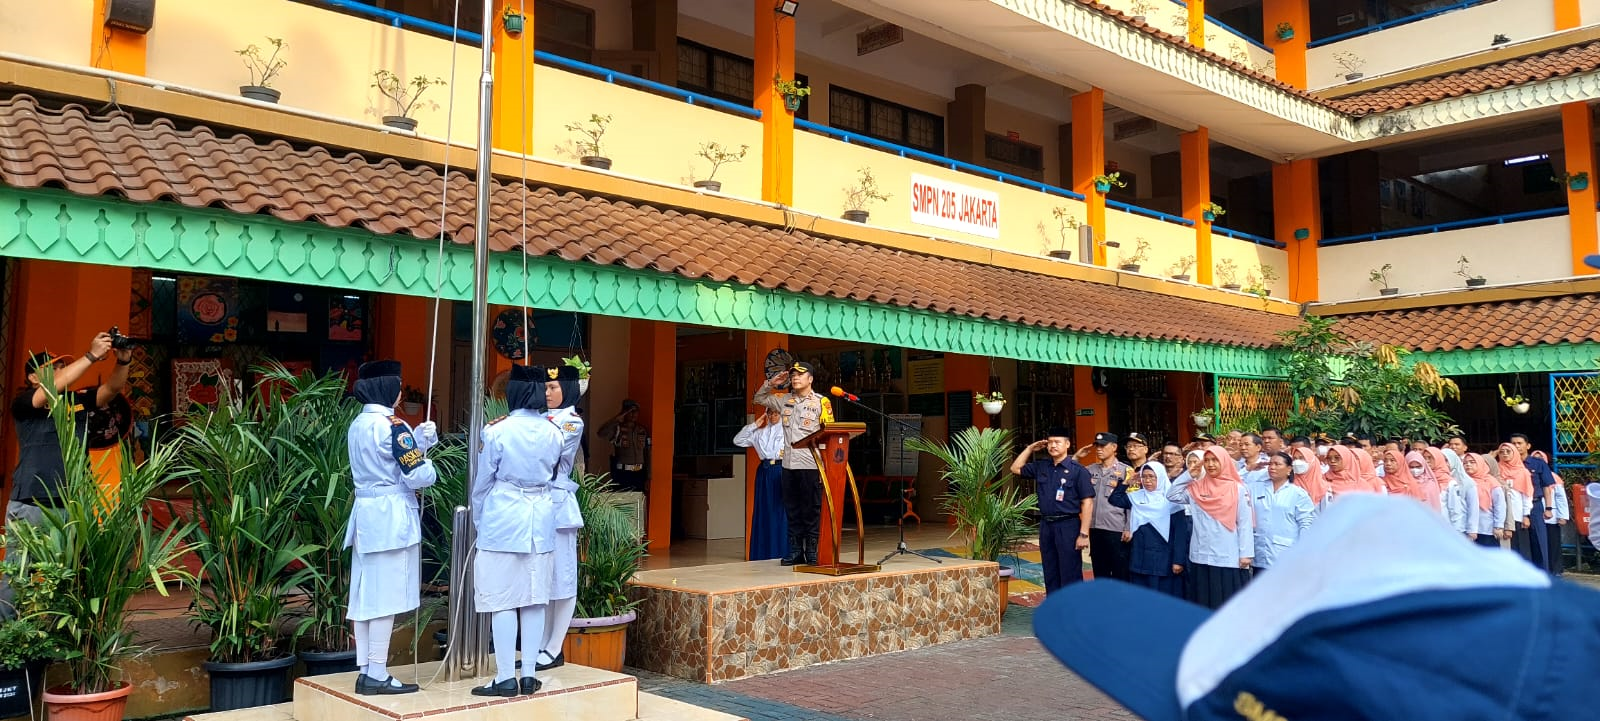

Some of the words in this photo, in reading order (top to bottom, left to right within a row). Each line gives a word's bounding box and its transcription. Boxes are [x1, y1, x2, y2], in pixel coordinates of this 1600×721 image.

[913, 182, 939, 217] SMPN
[941, 189, 956, 220] 205
[958, 193, 998, 229] JAKARTA
